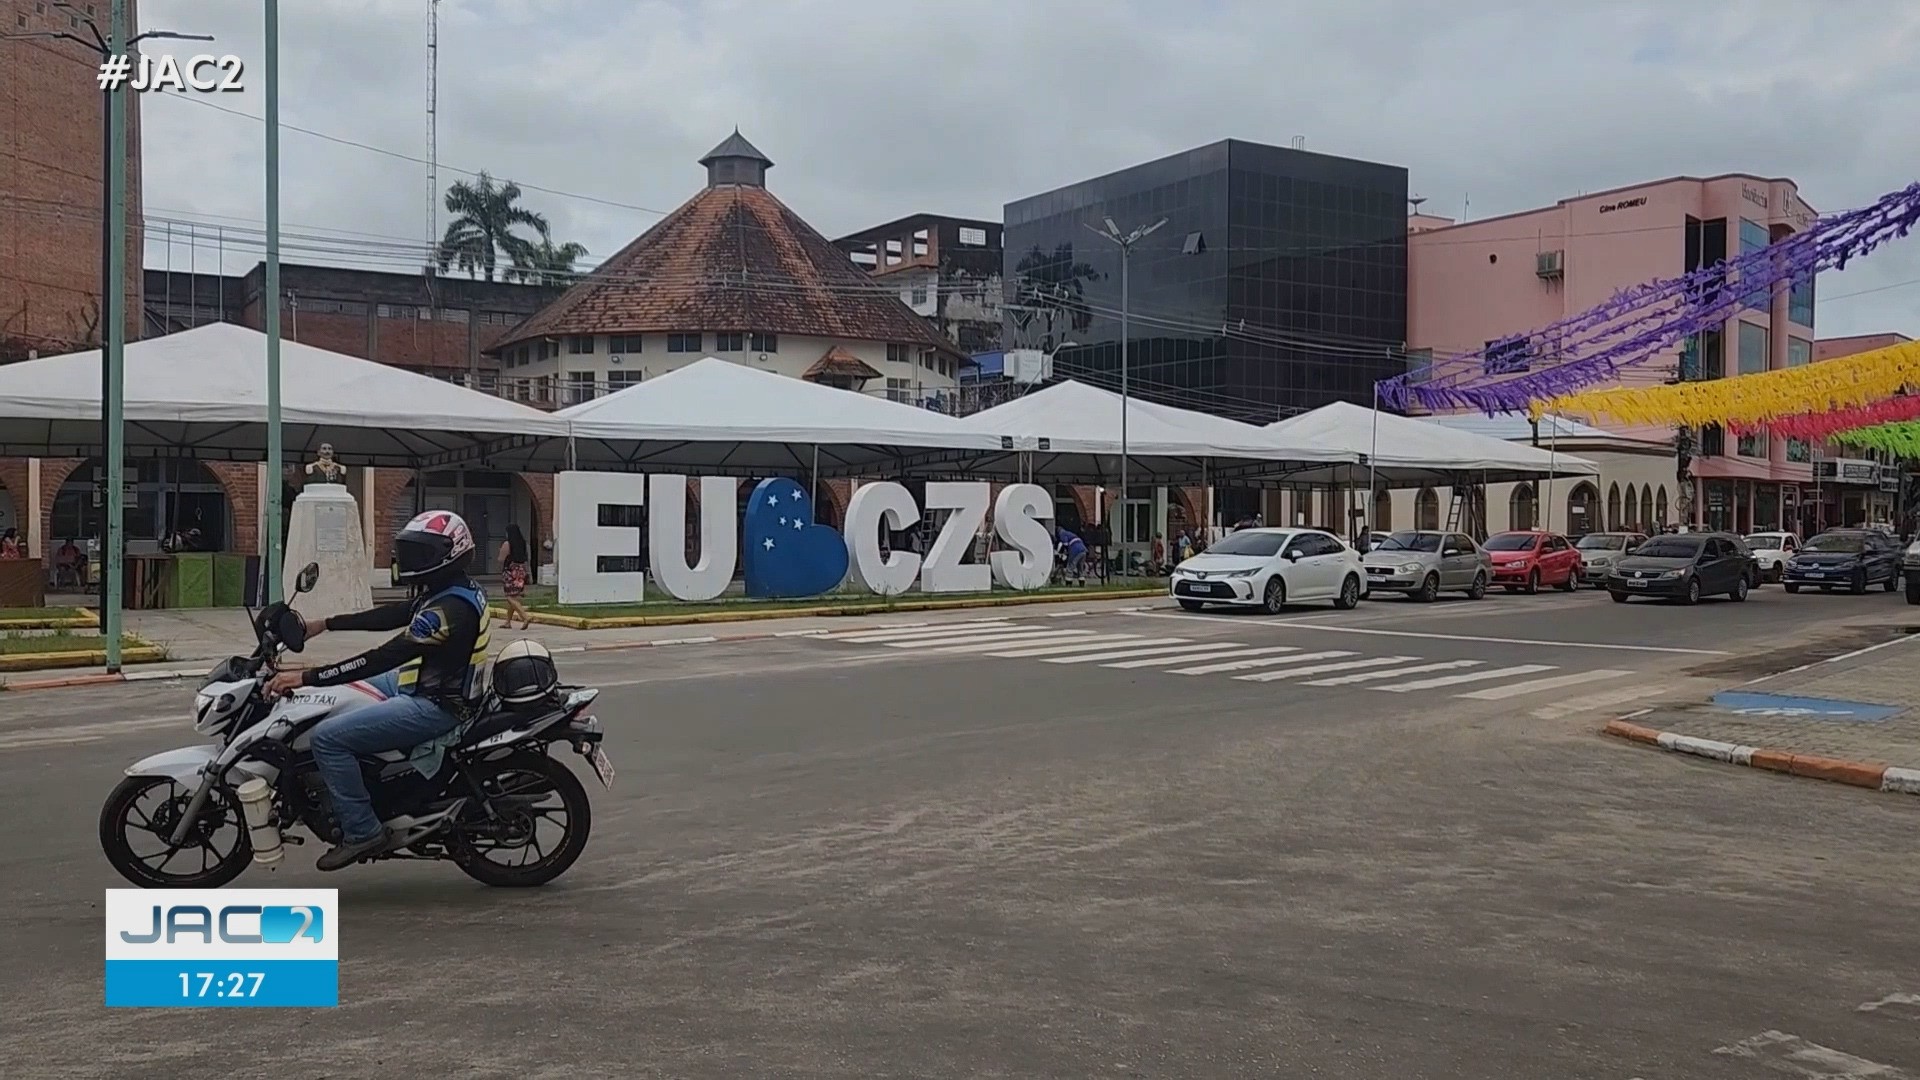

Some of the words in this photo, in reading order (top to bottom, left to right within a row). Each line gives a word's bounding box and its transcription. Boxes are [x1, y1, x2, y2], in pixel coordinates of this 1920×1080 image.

[558, 471, 736, 603] EU
[847, 482, 1054, 595] CZS
[318, 668, 339, 680] AGRO
[340, 657, 367, 673] BRUTO
[313, 693, 337, 706] TÁXI
